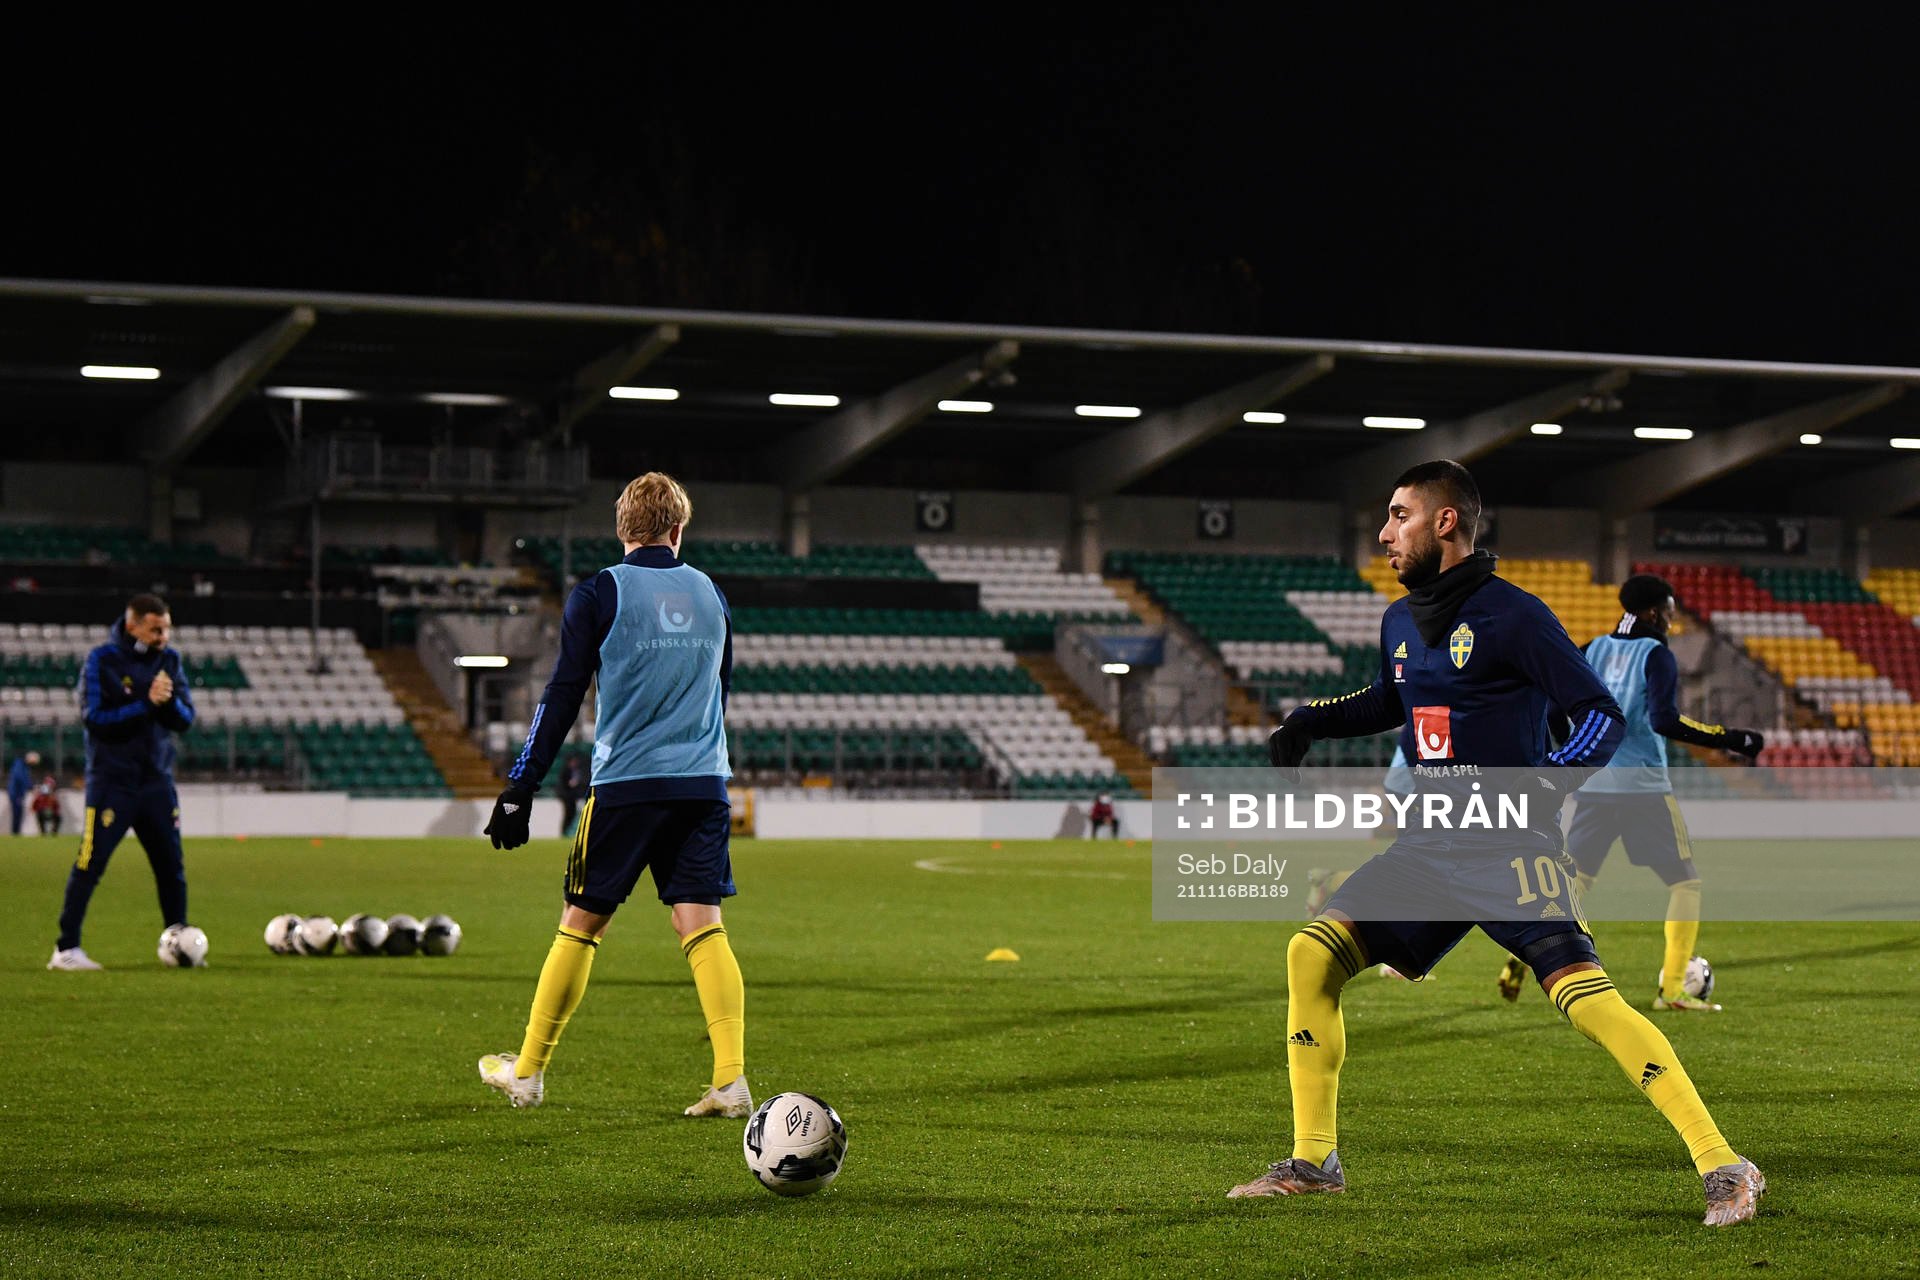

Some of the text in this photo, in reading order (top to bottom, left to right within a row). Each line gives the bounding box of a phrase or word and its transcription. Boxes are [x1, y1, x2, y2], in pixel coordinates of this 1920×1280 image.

[635, 638, 689, 651] SVENSKA
[1452, 764, 1483, 777] SPEL
[1510, 855, 1561, 906] 10
[800, 1110, 814, 1137] umbro
